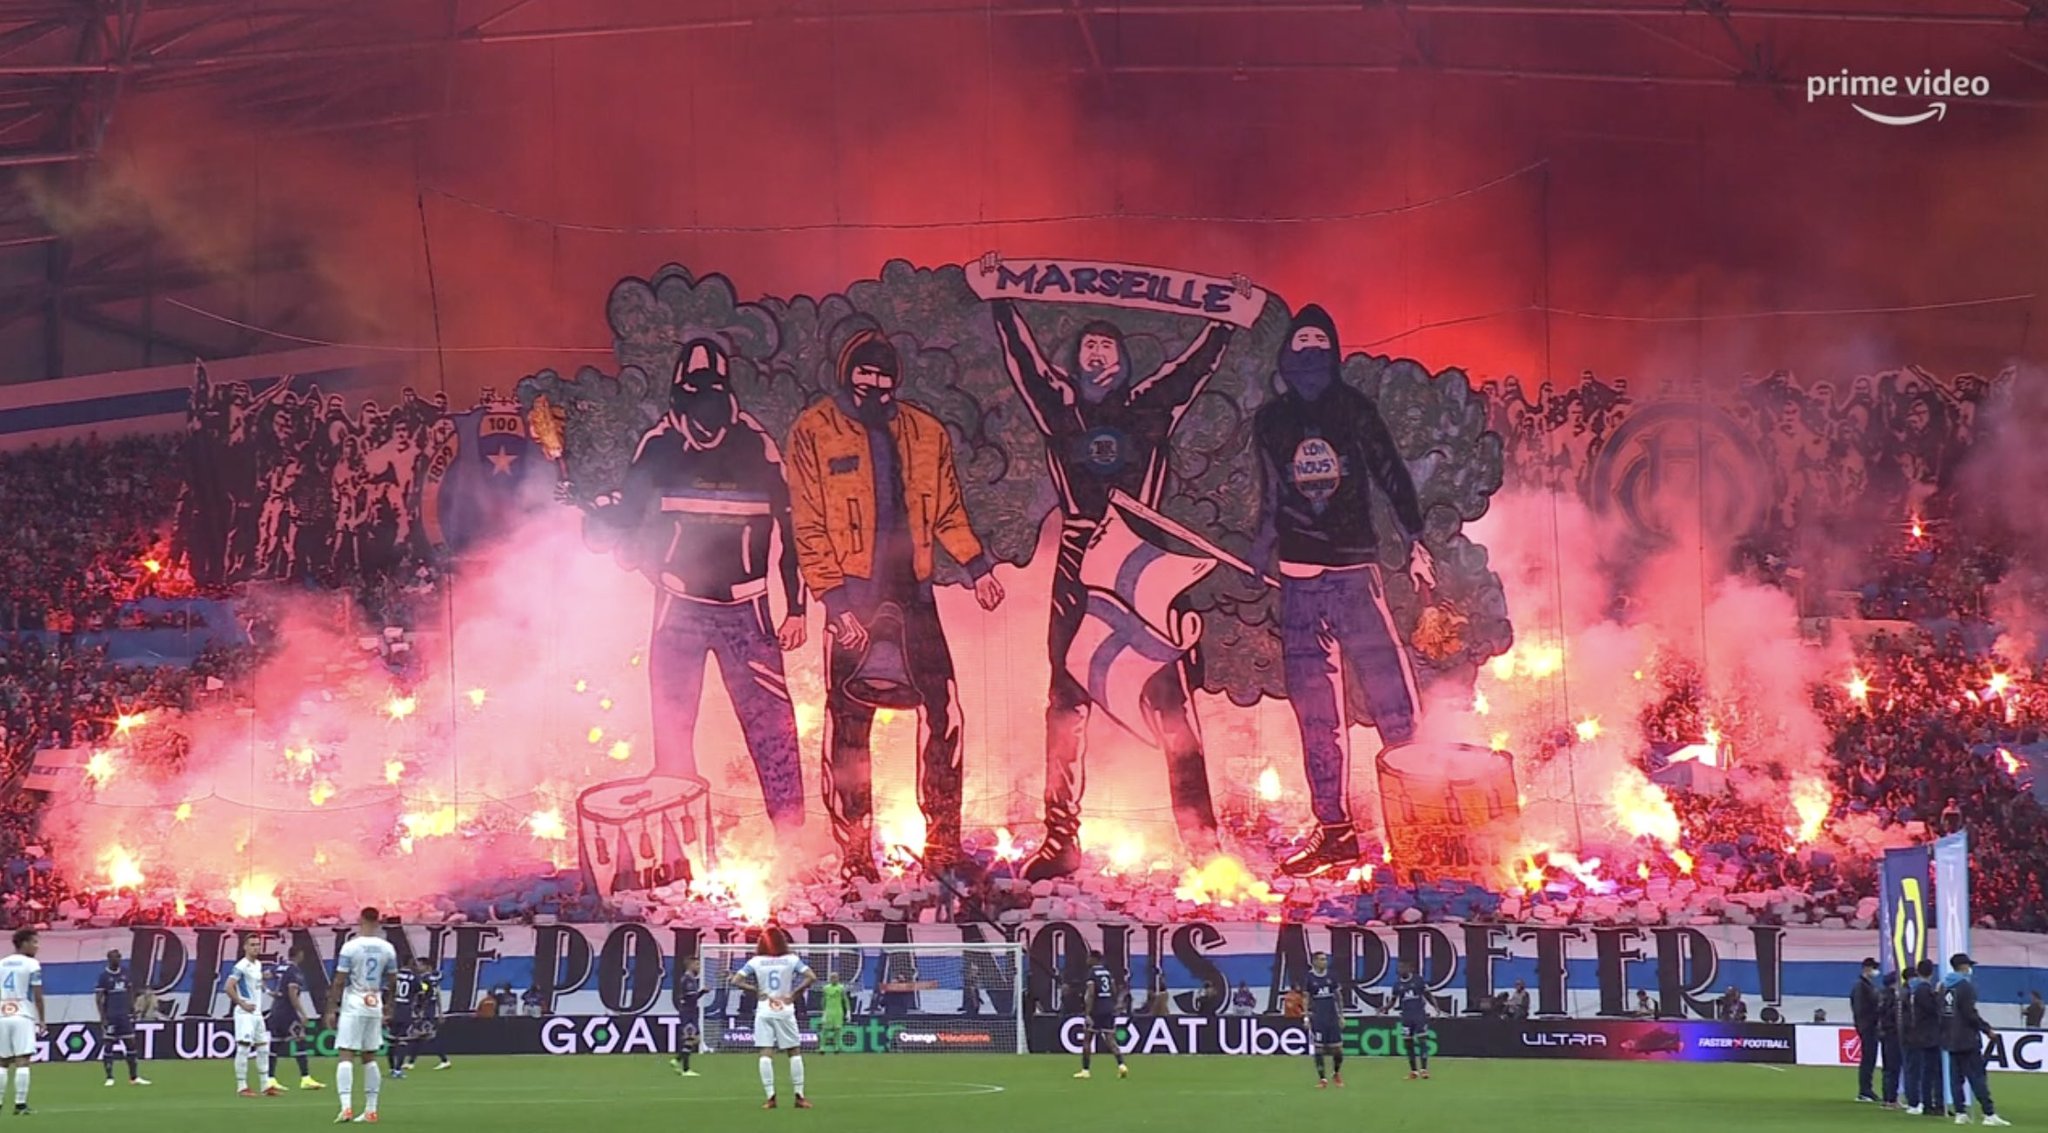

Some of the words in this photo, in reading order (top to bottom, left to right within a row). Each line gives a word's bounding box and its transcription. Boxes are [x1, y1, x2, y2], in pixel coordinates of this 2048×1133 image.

[996, 262, 1236, 313] MARSEILLE
[489, 417, 518, 432] 100
[428, 446, 454, 484] 1899
[365, 957, 379, 981] 2
[382, 923, 506, 1017] NE
[956, 919, 1233, 1017] NOUS
[3, 970, 16, 993] 4
[768, 969, 782, 992] 6
[1100, 975, 1110, 993] 3
[541, 1016, 681, 1054] GOAT
[1522, 1031, 1607, 1046] ULTRA
[1698, 1037, 1733, 1048] FASTER
[1743, 1038, 1791, 1049] FOOTBALL
